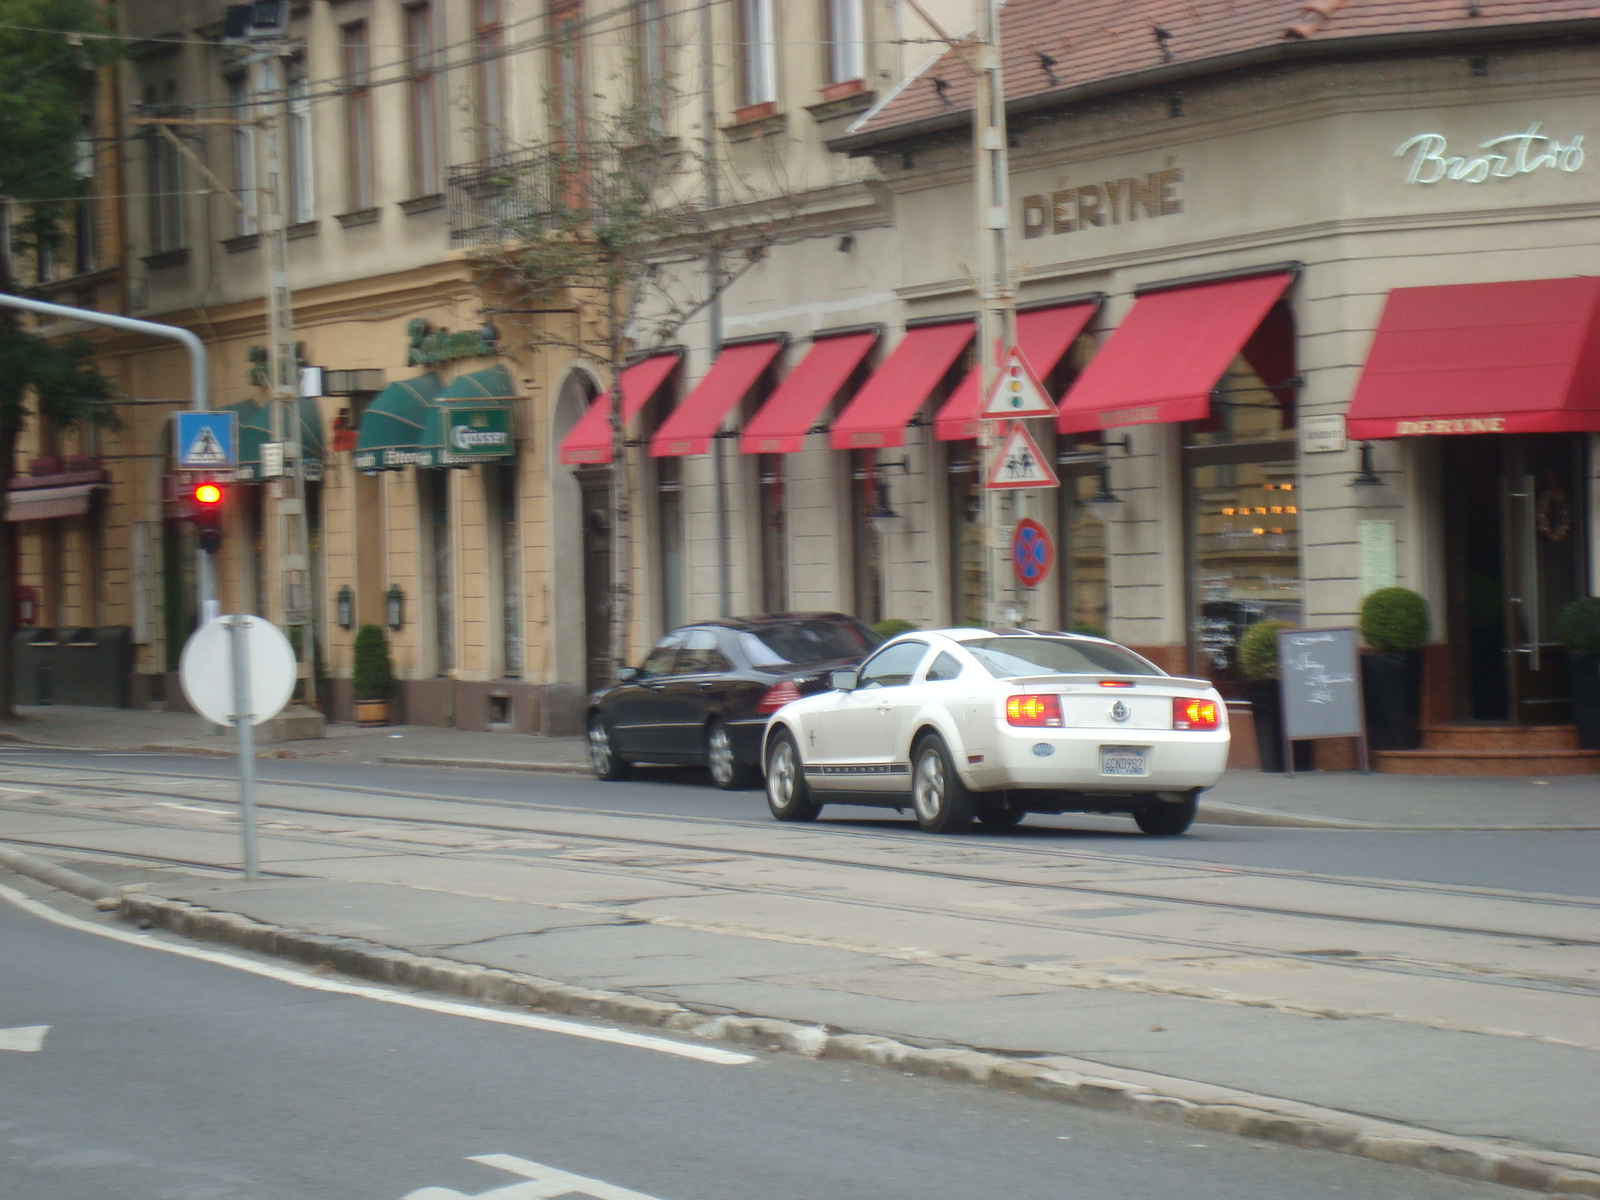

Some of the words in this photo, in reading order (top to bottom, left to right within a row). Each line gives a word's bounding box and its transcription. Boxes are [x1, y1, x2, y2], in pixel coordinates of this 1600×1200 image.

[1393, 121, 1585, 184] Bisztró
[1022, 155, 1185, 240] DÉRYNÉ
[1105, 757, 1143, 770] 6CND982
